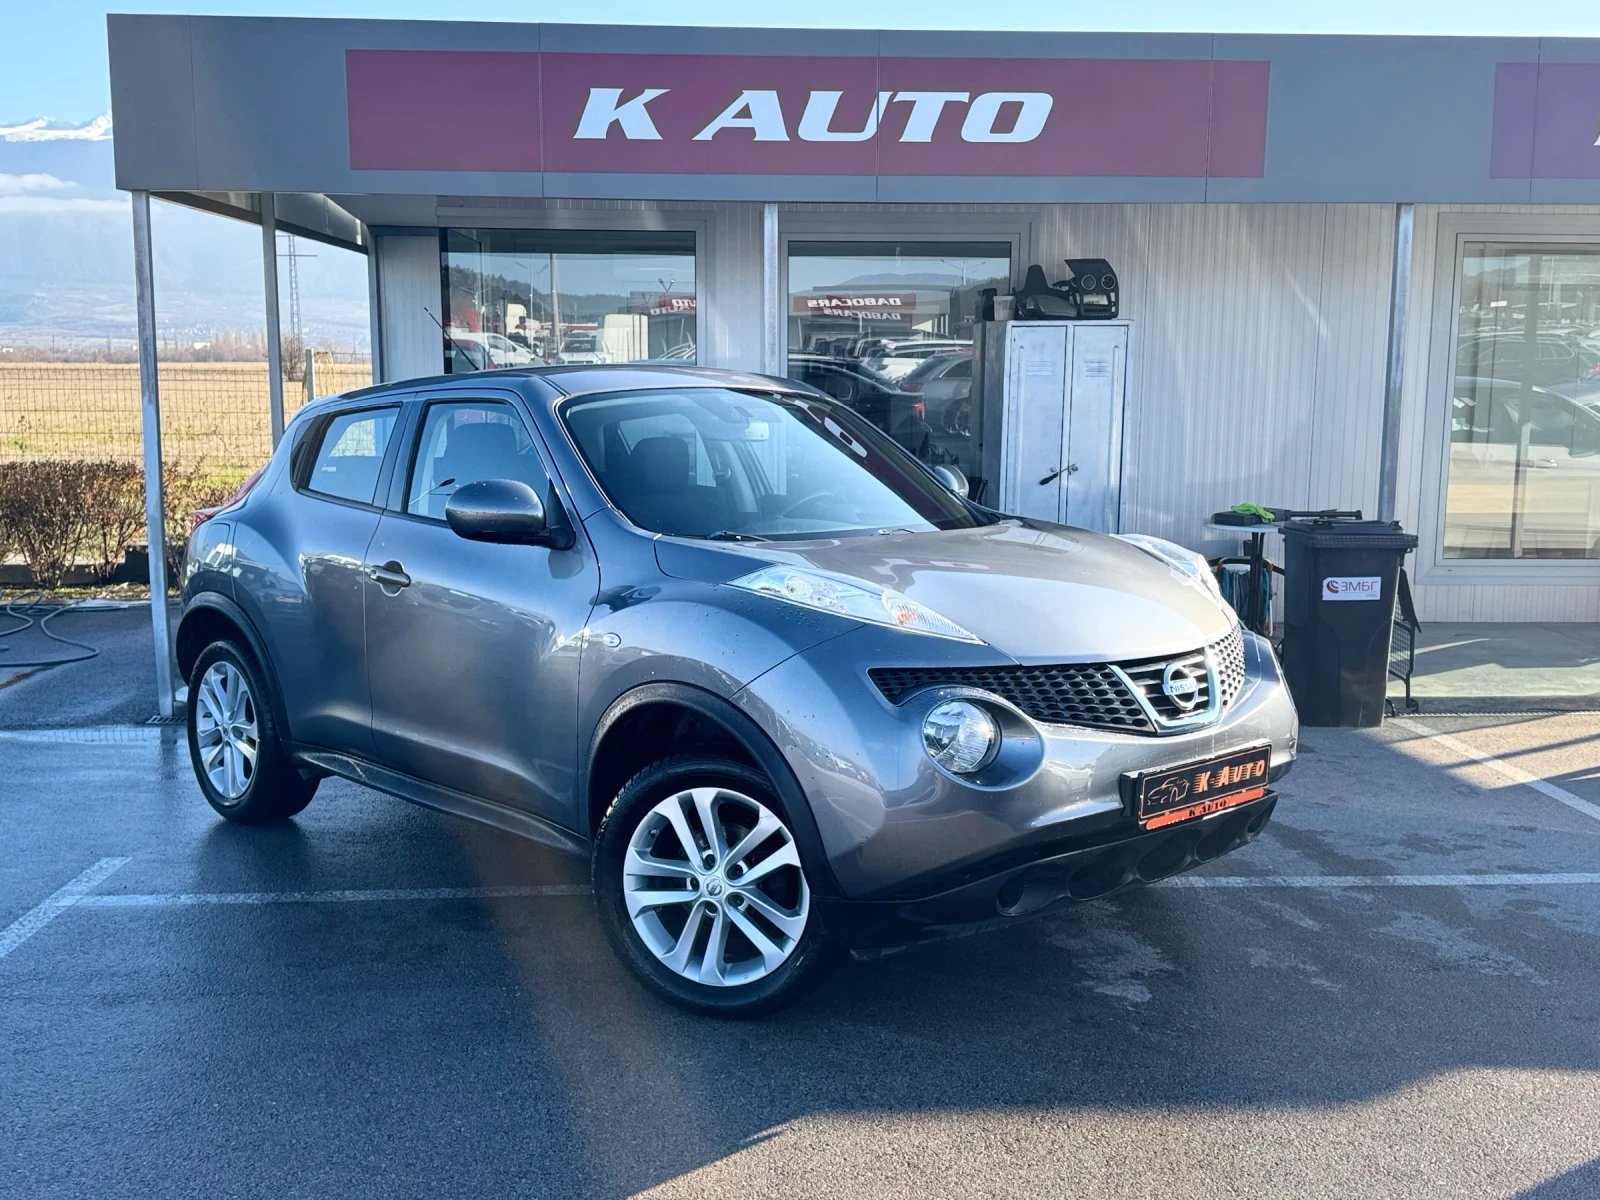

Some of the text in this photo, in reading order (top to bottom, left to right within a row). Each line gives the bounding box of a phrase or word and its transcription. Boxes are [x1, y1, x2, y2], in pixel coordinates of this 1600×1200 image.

[573, 87, 1054, 142] K AUTO
[1341, 581, 1378, 591] ЗМБГ
[1169, 682, 1194, 693] NISS
